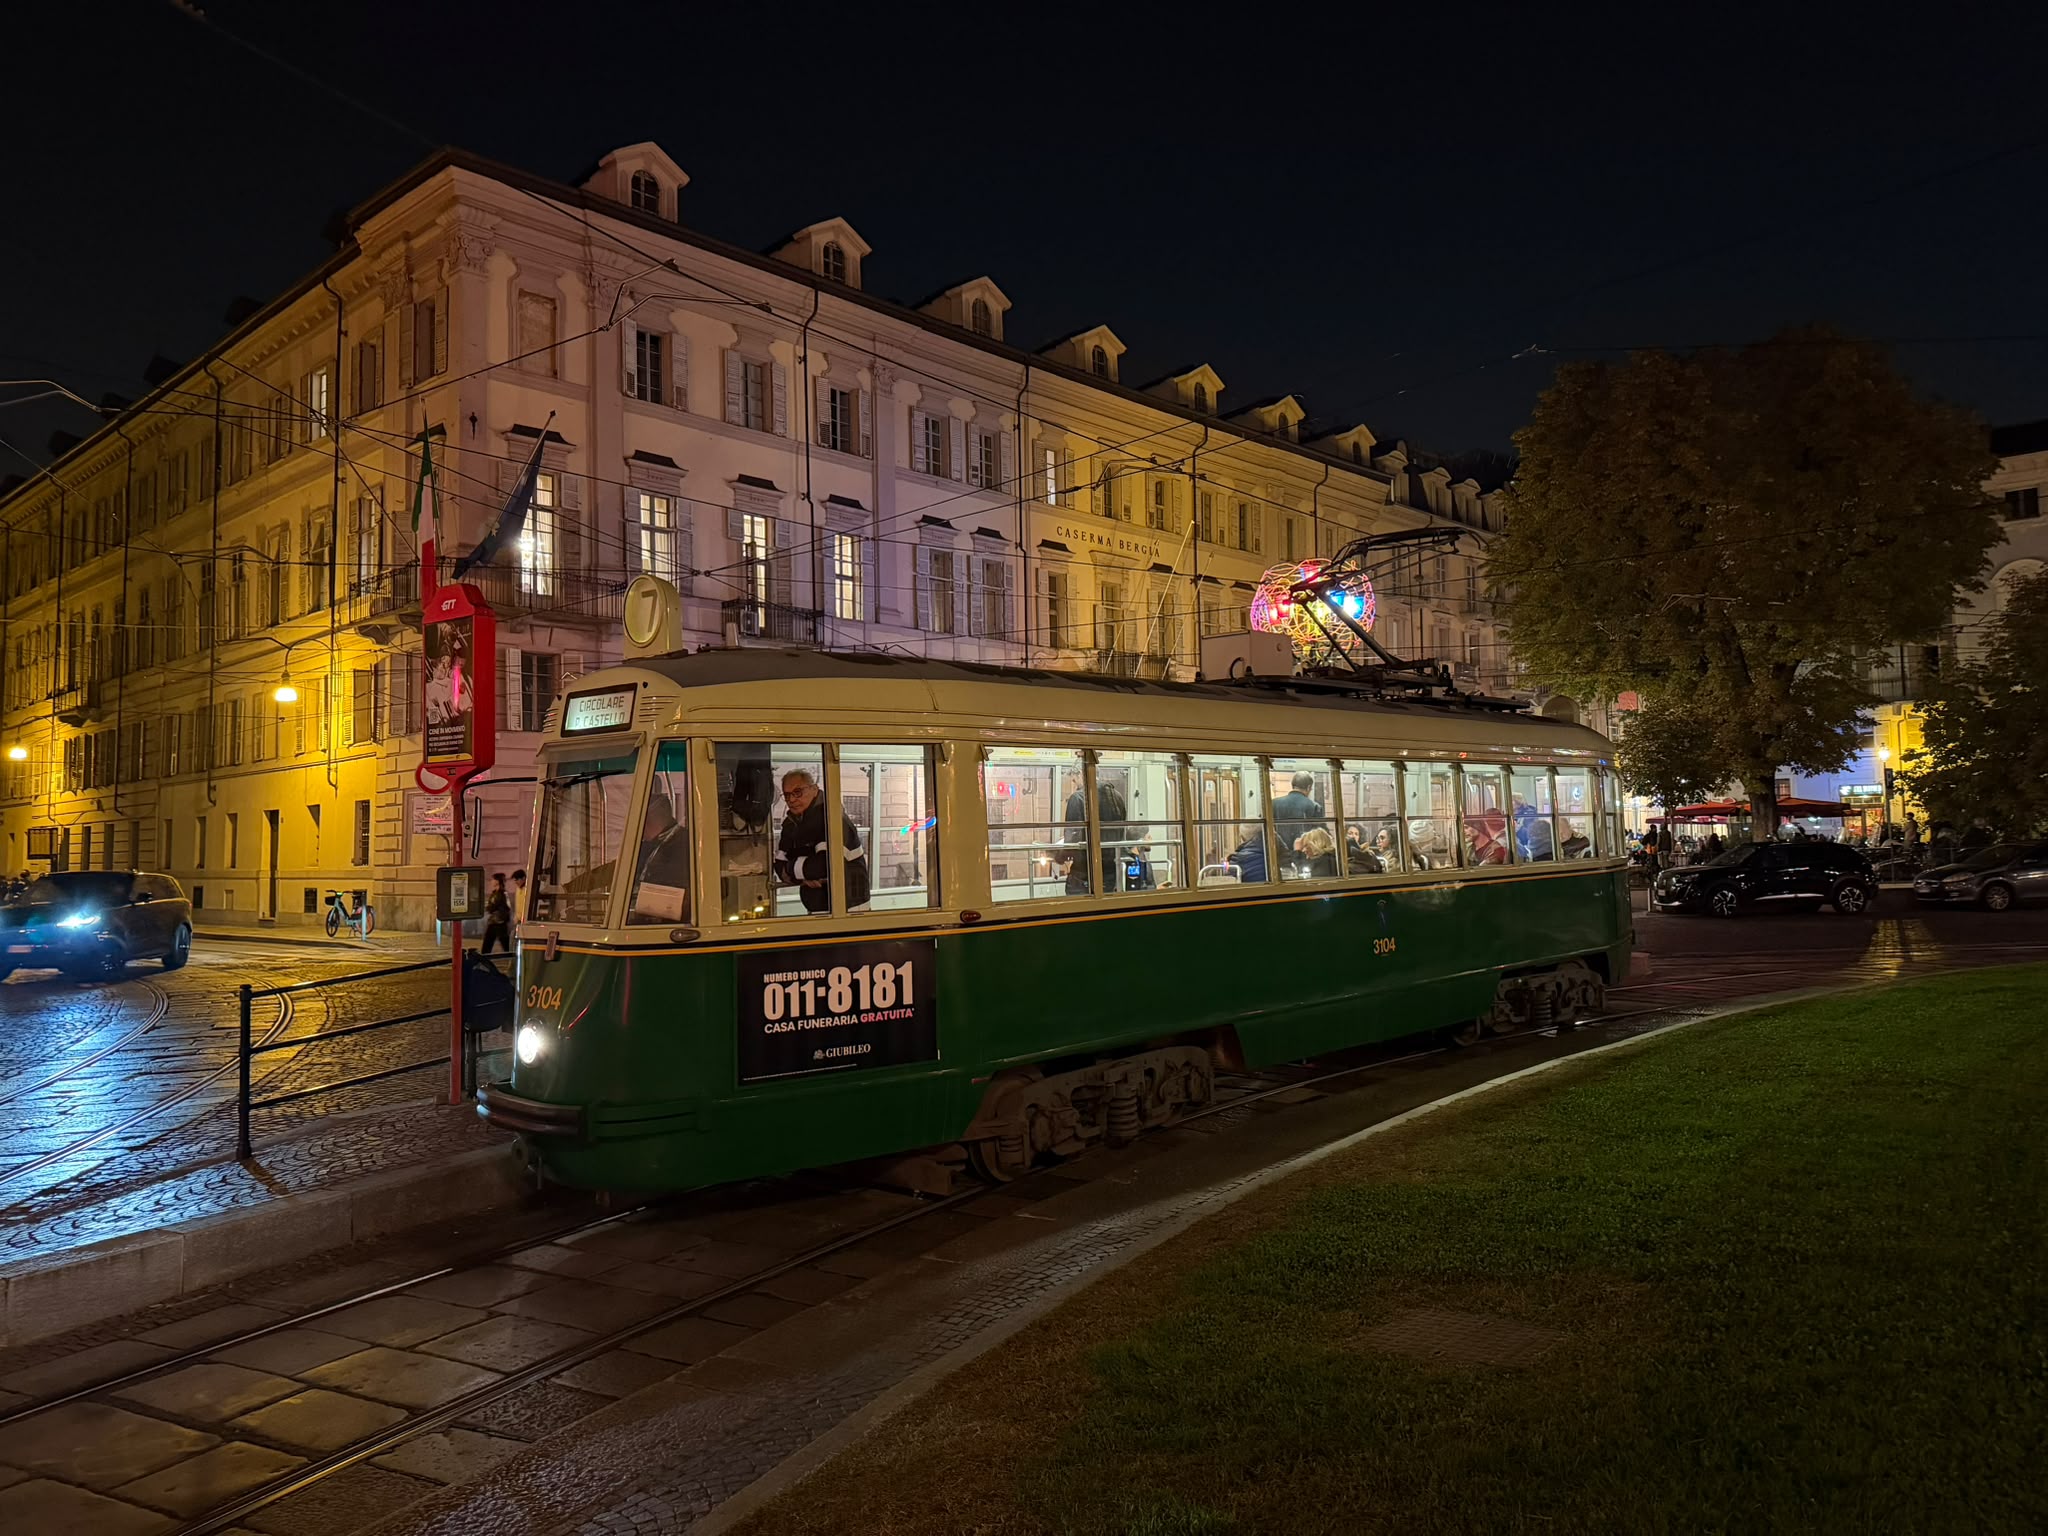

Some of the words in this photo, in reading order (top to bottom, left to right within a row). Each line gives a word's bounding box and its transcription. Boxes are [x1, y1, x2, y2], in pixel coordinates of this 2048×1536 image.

[1056, 526, 1112, 547] CASERMA
[1119, 539, 1160, 557] BERGIA
[441, 598, 457, 611] GTT
[641, 589, 657, 633] 7
[579, 695, 625, 713] CIRCOLARE
[583, 711, 625, 727] CASTELLO
[1373, 937, 1396, 955] 3104
[763, 971, 799, 983] NUMERO
[800, 969, 826, 980] UNICO
[527, 984, 563, 1011] 3104
[763, 960, 914, 1021] 011-8181
[764, 1022, 796, 1034] CASA
[797, 1014, 859, 1030] FUNERARIA
[825, 1043, 872, 1058] GIUBILEO
